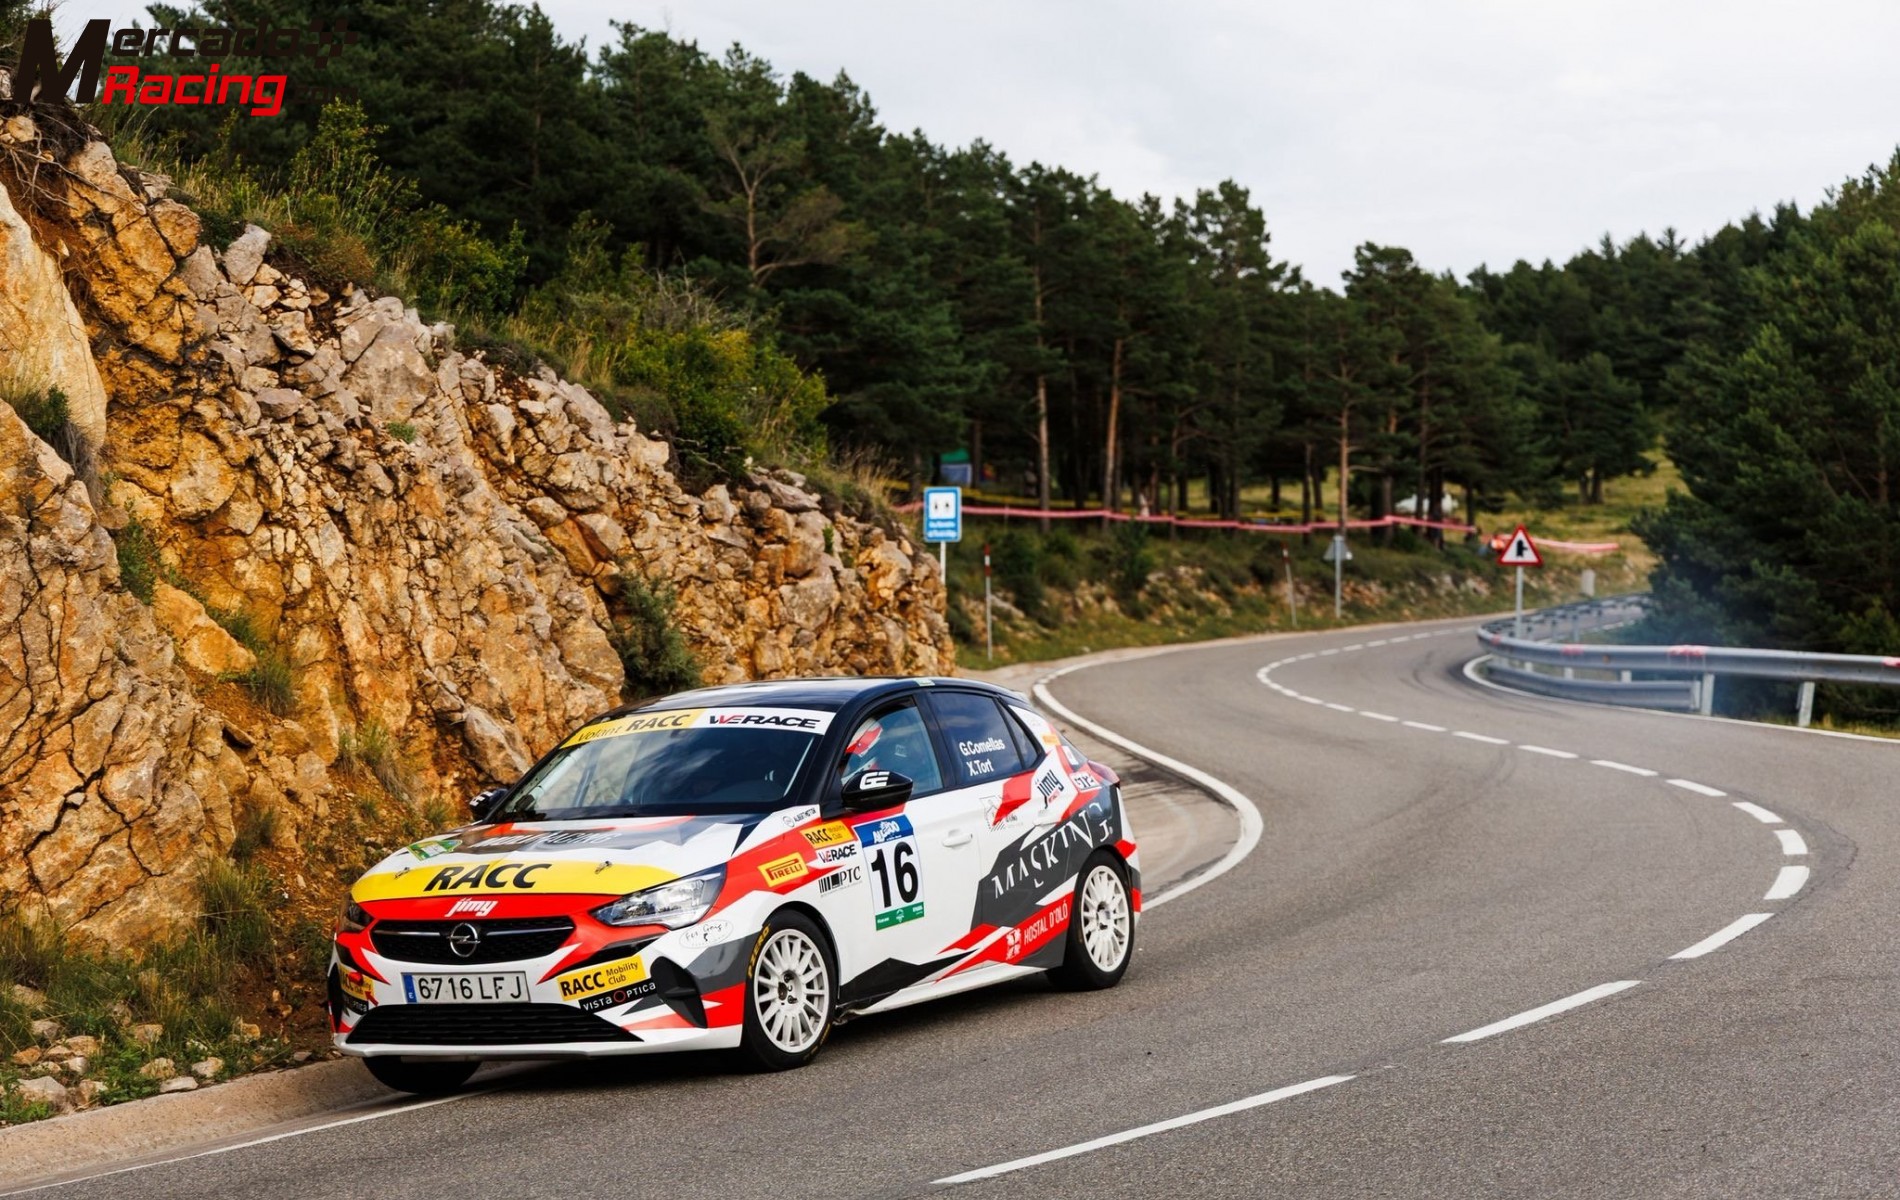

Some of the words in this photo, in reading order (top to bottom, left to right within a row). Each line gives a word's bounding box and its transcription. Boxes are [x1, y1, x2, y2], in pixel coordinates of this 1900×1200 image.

[624, 714, 691, 732] RACC
[709, 714, 821, 729] WERACE
[965, 758, 995, 777] X.Tort
[805, 828, 833, 845] RACC
[423, 863, 552, 892] RACC
[765, 858, 803, 881] PIRELLI
[839, 866, 862, 888] PTC
[871, 841, 919, 908] 16
[445, 897, 499, 917] jimy
[1023, 916, 1049, 946] HOSTAL
[605, 961, 639, 977] Mobility
[418, 977, 474, 1000] 6716
[559, 971, 606, 998] RACC
[608, 974, 627, 986] Club
[408, 992, 415, 1000] E
